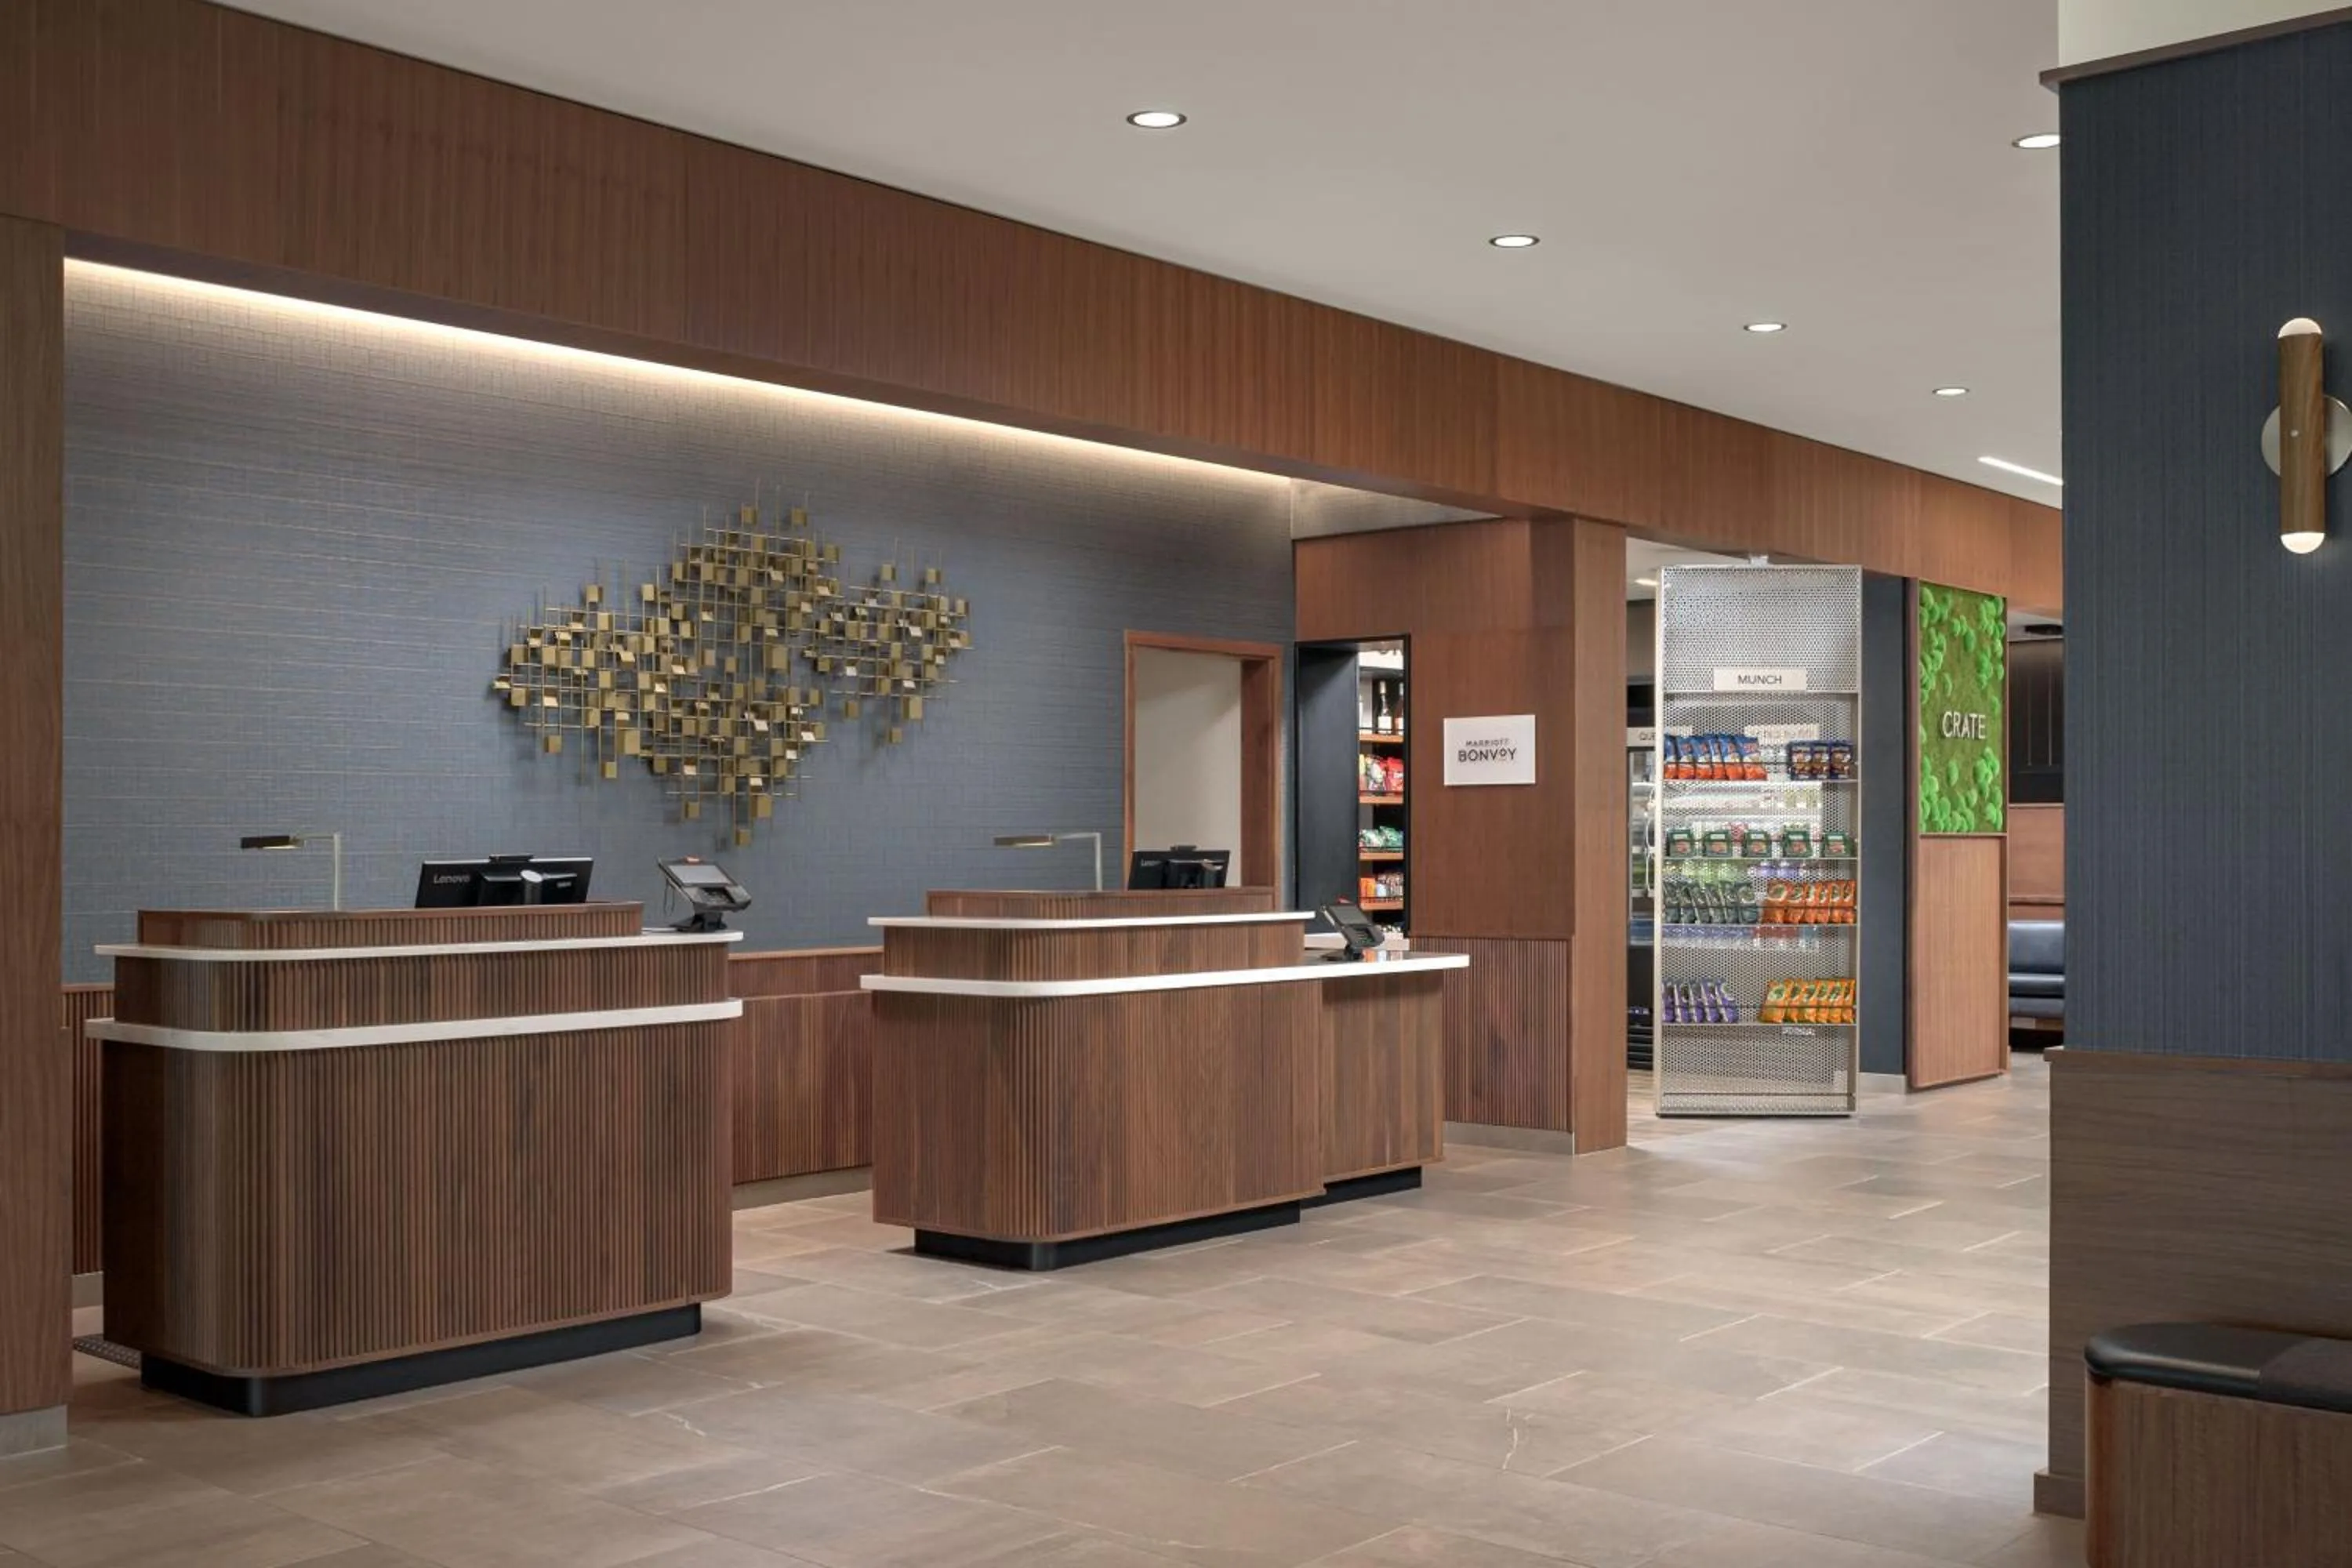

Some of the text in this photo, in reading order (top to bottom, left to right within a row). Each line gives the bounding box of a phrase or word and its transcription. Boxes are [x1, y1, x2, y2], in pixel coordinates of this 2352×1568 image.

[1737, 674, 1782, 684] MUNCH
[1942, 710, 1987, 740] CRATE
[1458, 747, 1517, 763] BONVOY
[434, 873, 470, 885] Lenovo
